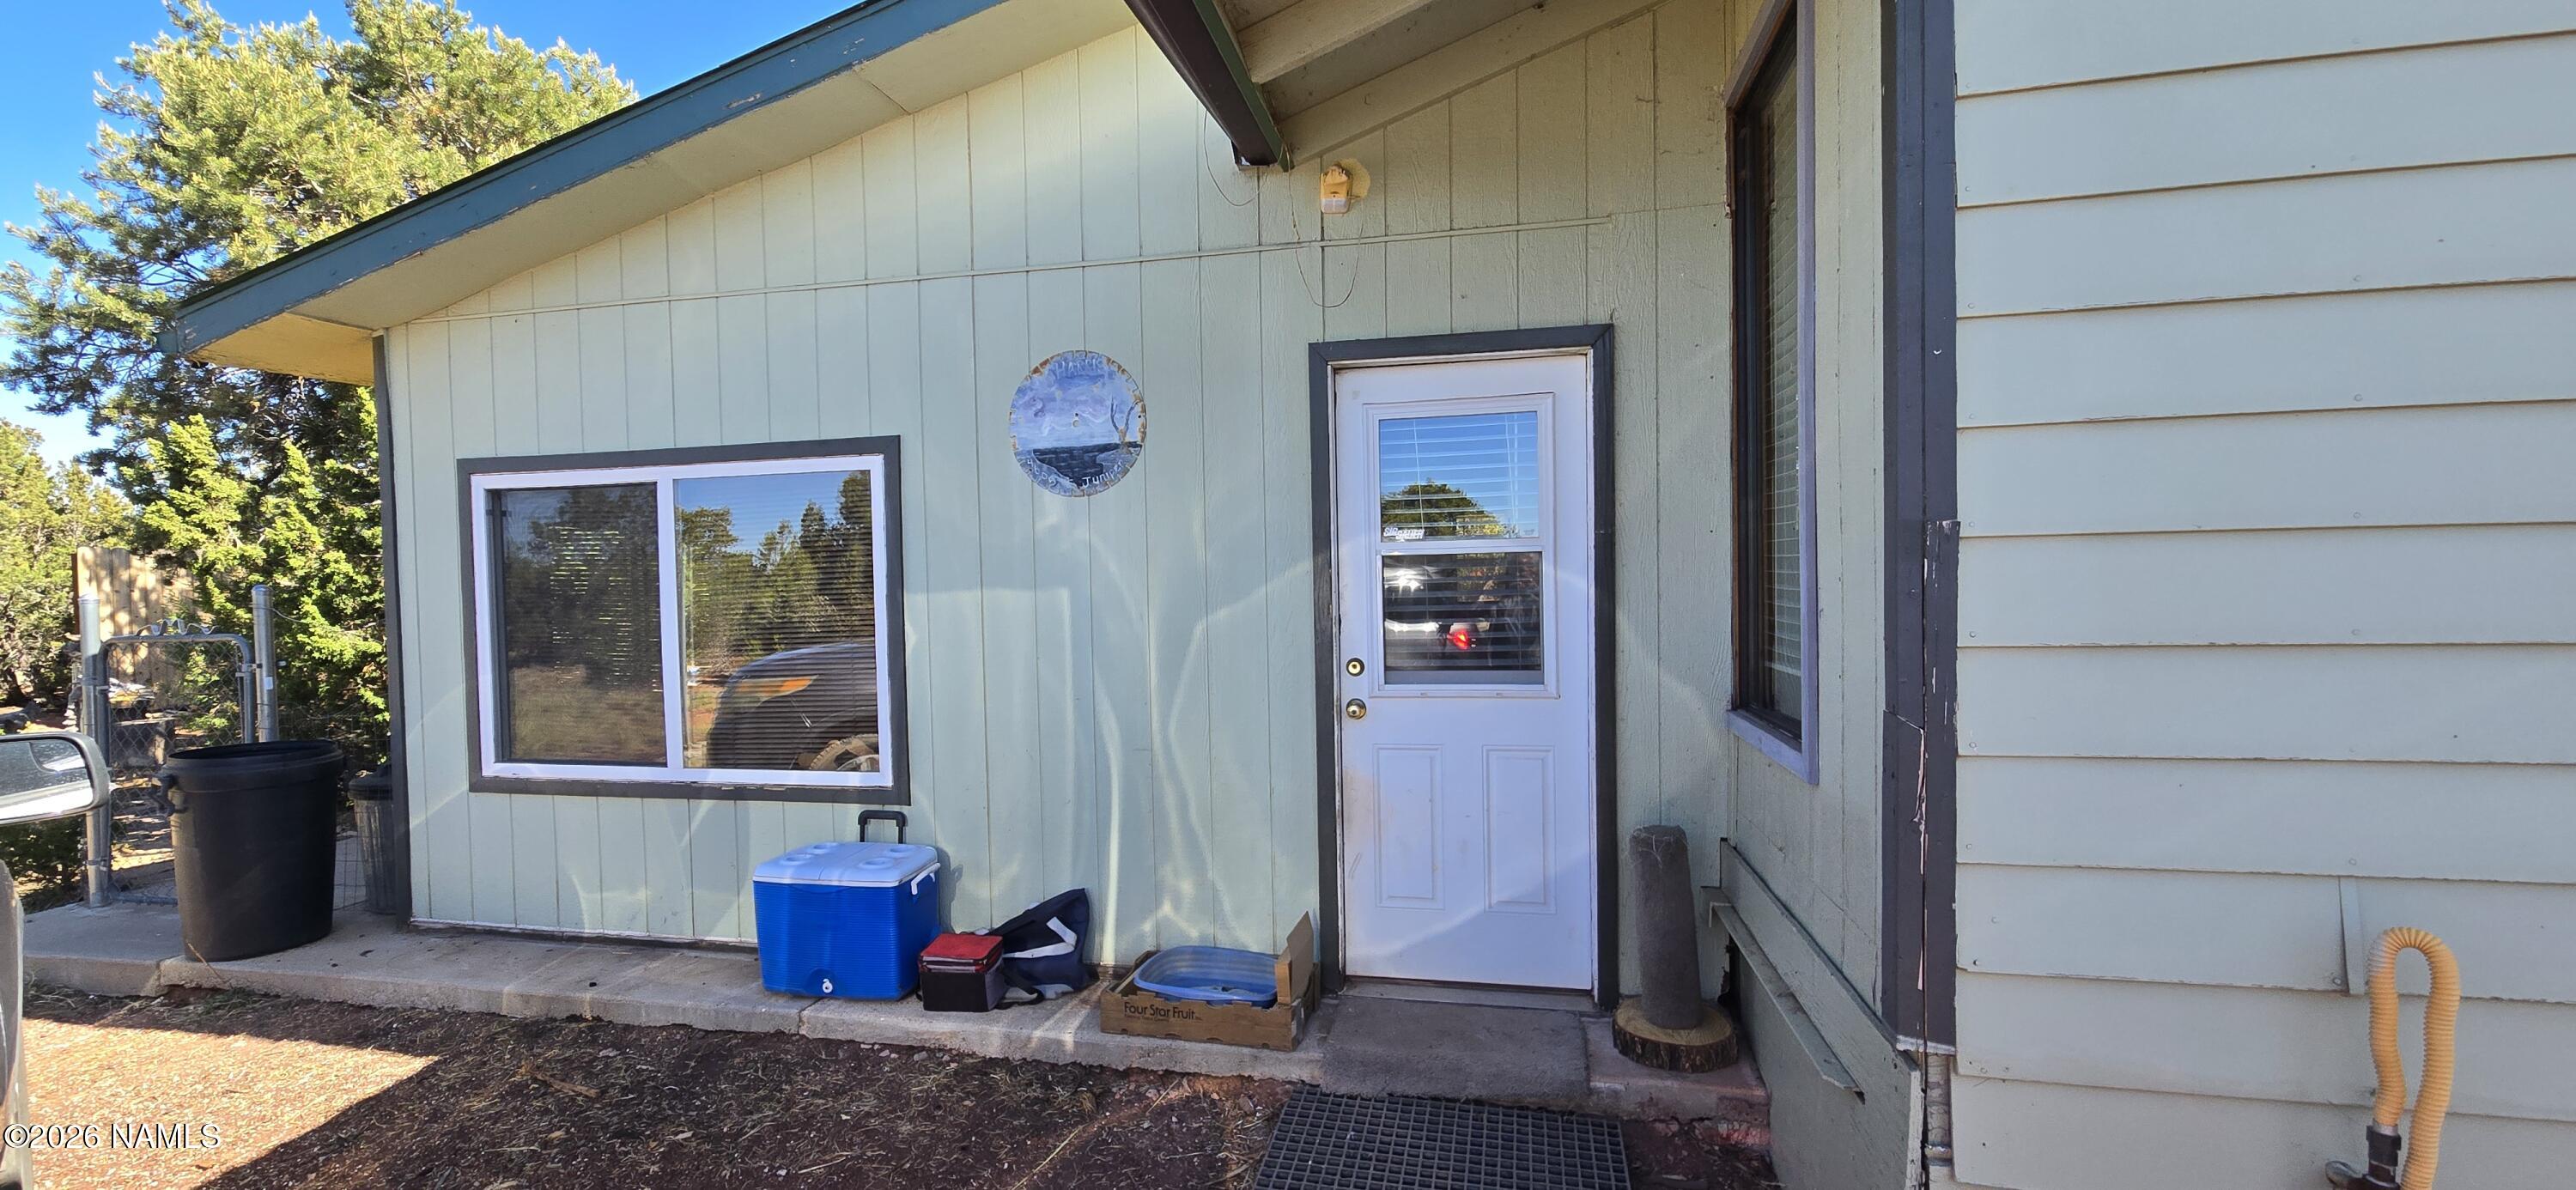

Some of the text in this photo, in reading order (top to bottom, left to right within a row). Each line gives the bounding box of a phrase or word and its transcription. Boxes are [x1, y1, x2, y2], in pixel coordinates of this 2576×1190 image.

[1124, 1001, 1148, 1015] Four
[1150, 1004, 1170, 1017] Star
[1172, 1006, 1196, 1020] Fruit
